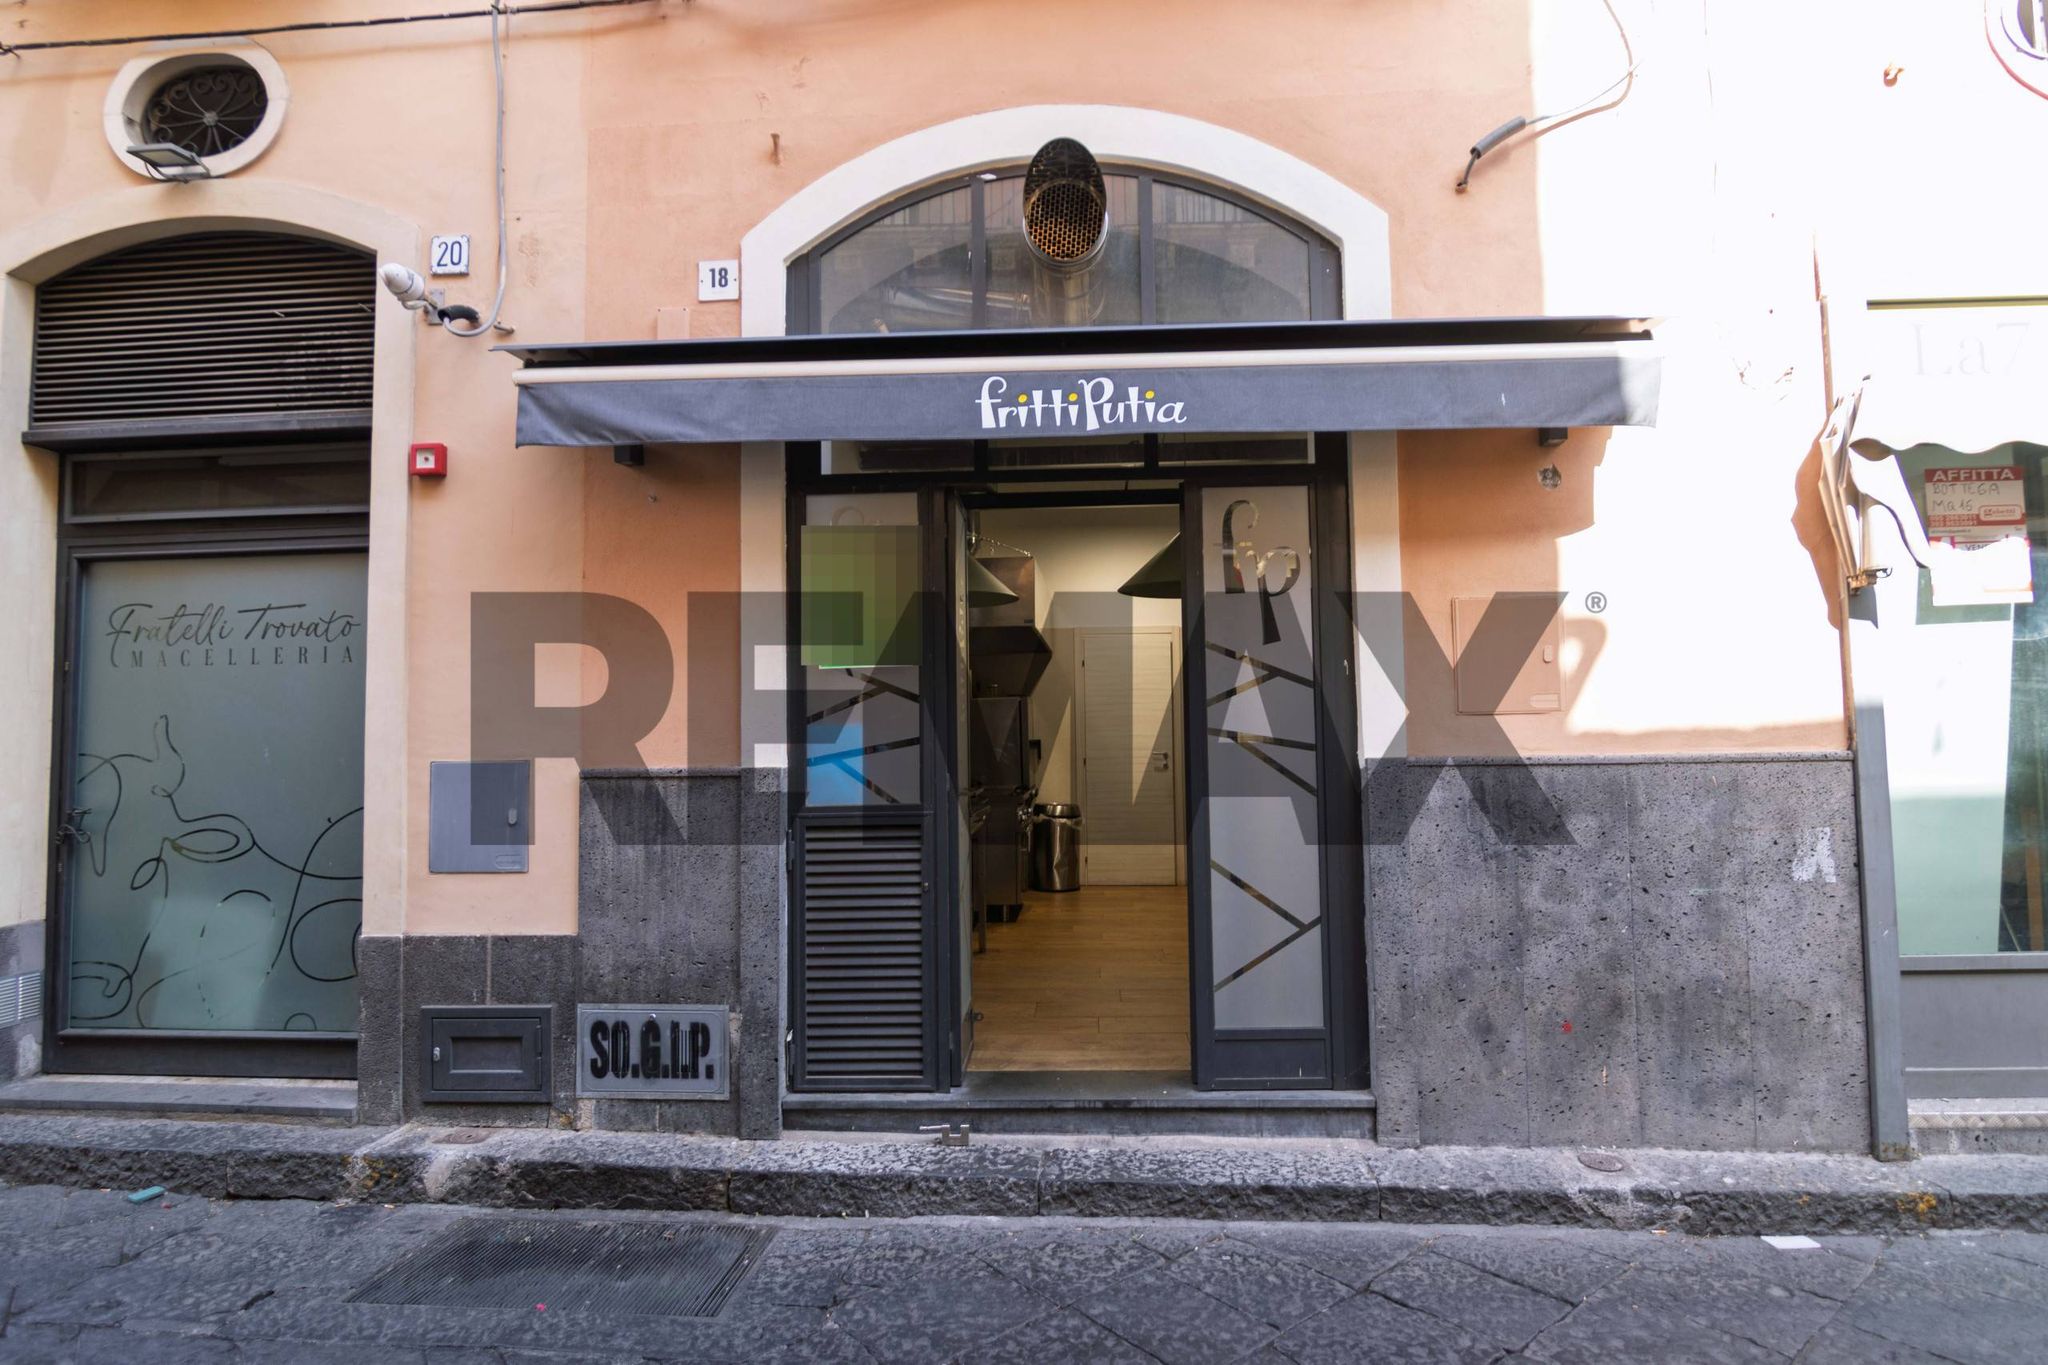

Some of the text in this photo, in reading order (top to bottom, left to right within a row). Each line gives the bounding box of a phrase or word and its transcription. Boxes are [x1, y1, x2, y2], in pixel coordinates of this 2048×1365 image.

[436, 241, 463, 267] 20
[709, 267, 729, 288] 18
[1932, 468, 2014, 482] AFFITTA
[106, 603, 361, 668] Fratelli Trovato
[131, 646, 353, 668] MACELLERIA
